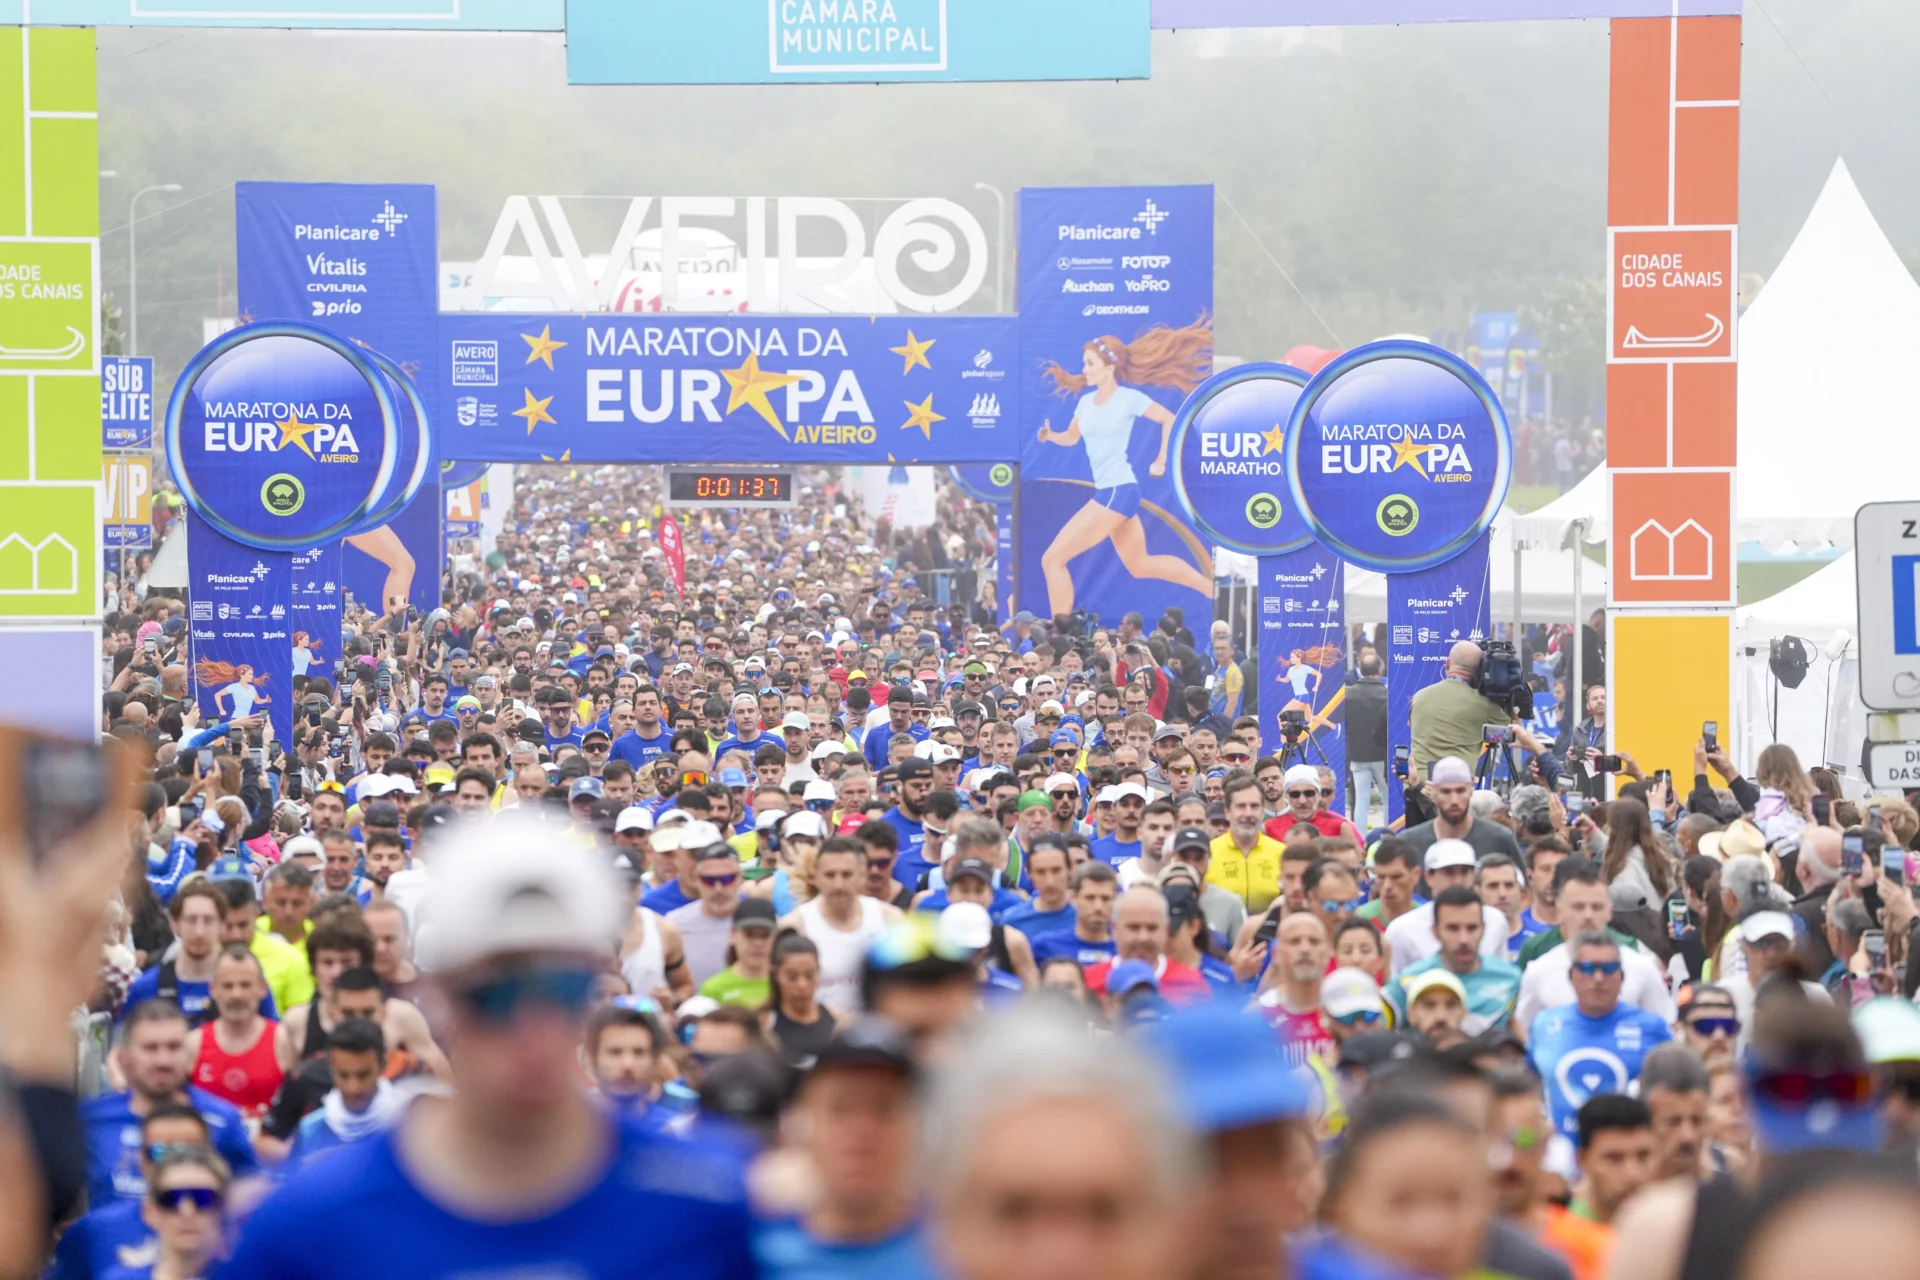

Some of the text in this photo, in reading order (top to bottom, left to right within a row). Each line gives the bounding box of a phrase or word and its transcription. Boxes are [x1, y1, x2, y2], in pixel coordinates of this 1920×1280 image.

[783, 27, 934, 52] MUNICIPAL
[295, 224, 380, 241] Planicare
[1058, 224, 1141, 240] Planicare
[476, 195, 988, 313] AVEIRO
[1622, 254, 1683, 270] CIDADE
[306, 252, 367, 276] Vitalis
[1062, 279, 1114, 293] Auchan
[1125, 280, 1170, 292] YoPRO
[1622, 271, 1722, 288] DOS CANAIS
[21, 283, 83, 299] CANAIS
[306, 283, 367, 293] CIVILRIA
[326, 299, 362, 316] prio
[1096, 305, 1149, 315] DECATHLON
[586, 327, 848, 357] MARATONA DA
[455, 347, 495, 358] AVEIRO
[105, 364, 143, 392] SUB
[455, 373, 495, 381] MUNICIPAL
[586, 368, 875, 423] EURPA
[101, 392, 150, 421] ELITE
[205, 402, 352, 419] MARATONA DA
[205, 422, 360, 452] EURPA
[794, 425, 877, 444] AVEIRO
[1322, 423, 1465, 441] MARATONA DA
[320, 454, 358, 463] AVEIRO
[1322, 444, 1472, 473] EURPA
[1201, 461, 1283, 475] MARATHO
[1434, 473, 1472, 482] AVEIRO
[103, 464, 148, 519] VIP
[697, 477, 779, 497] 0:01:37
[207, 574, 255, 583] Planicare
[1276, 574, 1314, 582] Planicare
[1407, 599, 1454, 608] Planicare
[1263, 620, 1282, 628] Vitalis
[194, 629, 216, 637] Vitalis
[270, 631, 286, 639] prio
[1394, 653, 1414, 661] Vitalis
[1889, 768, 1920, 780] DAS
